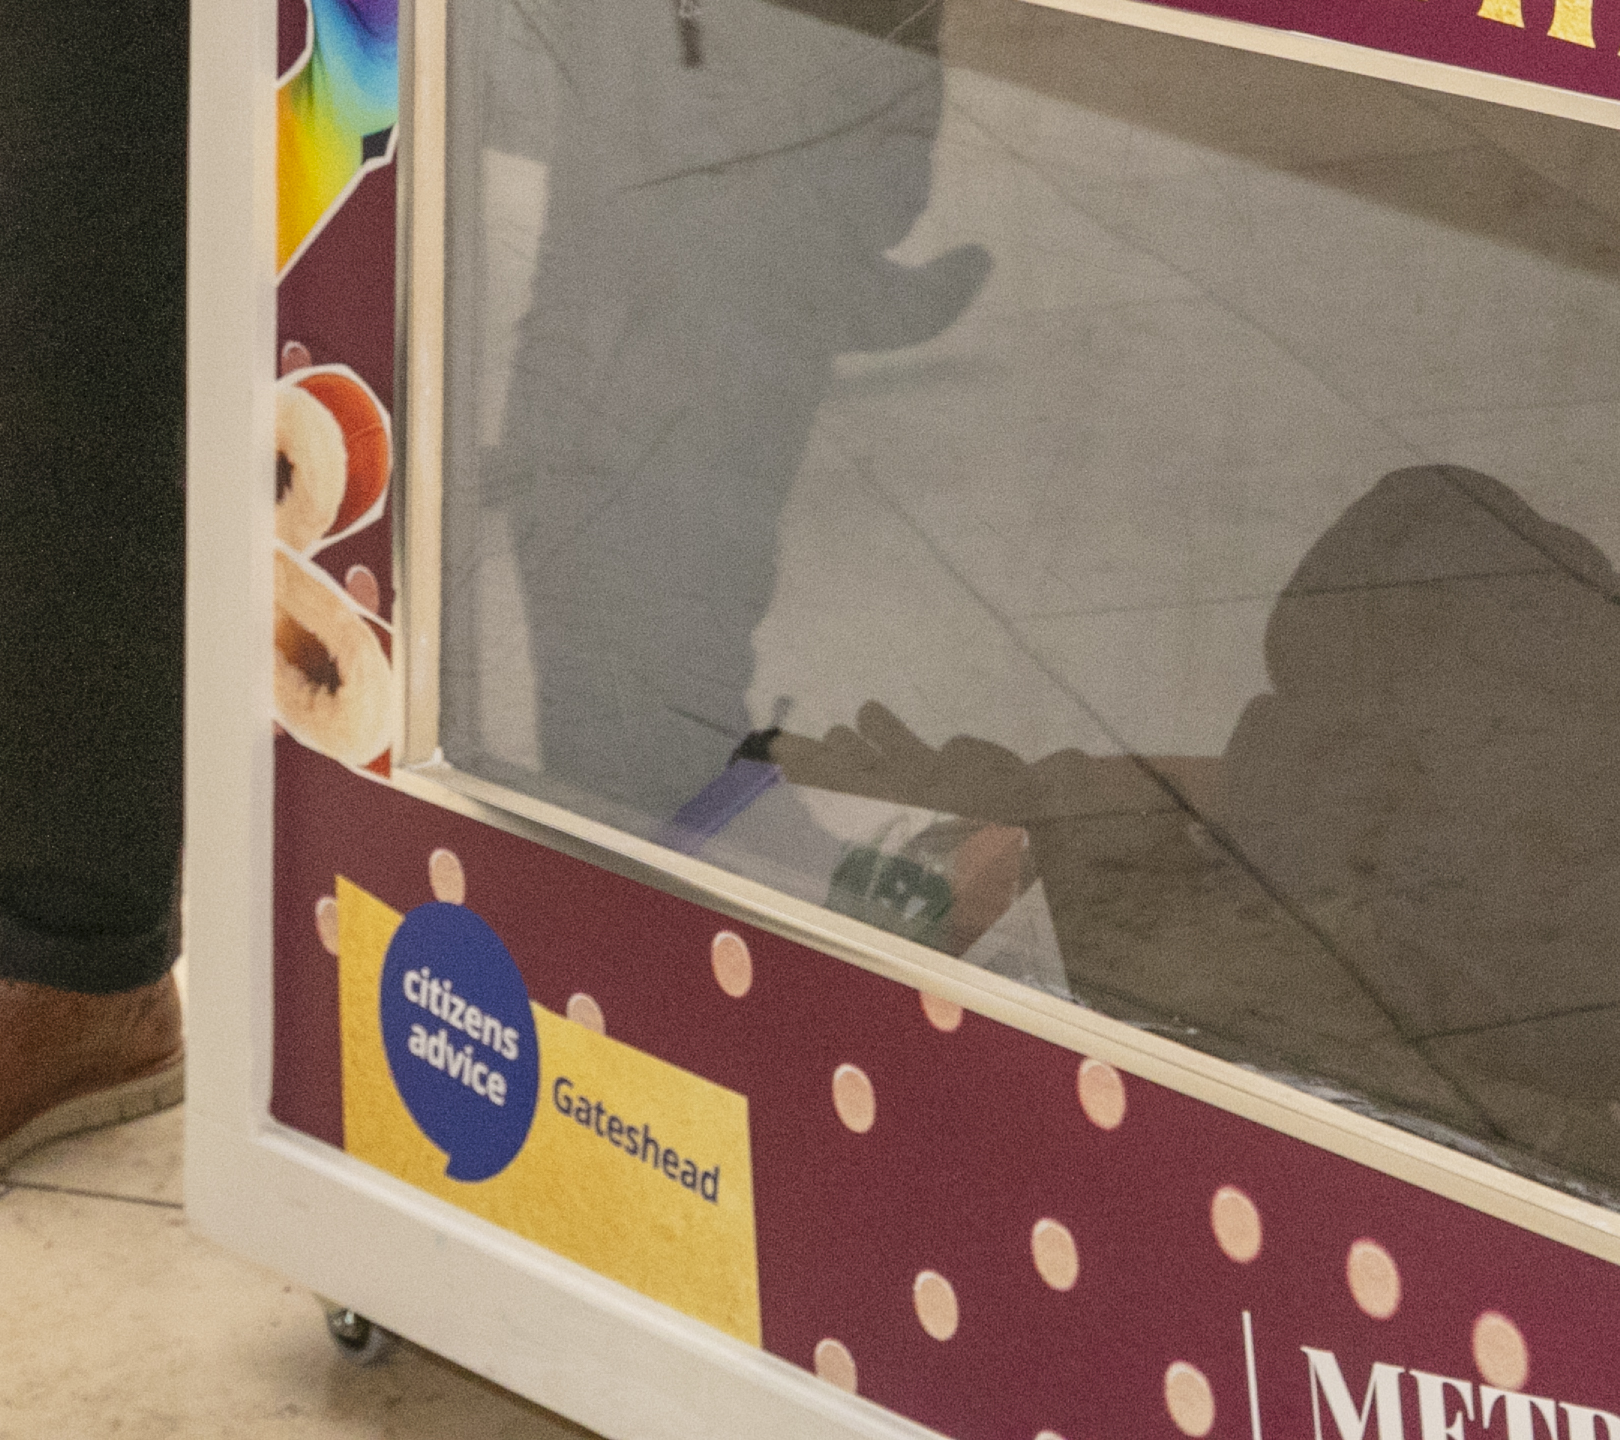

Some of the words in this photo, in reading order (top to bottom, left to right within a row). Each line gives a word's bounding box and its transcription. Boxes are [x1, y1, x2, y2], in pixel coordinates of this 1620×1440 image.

[402, 965, 520, 1062] citizens
[407, 1023, 508, 1108] advice
[551, 1075, 721, 1207] Gateshead
